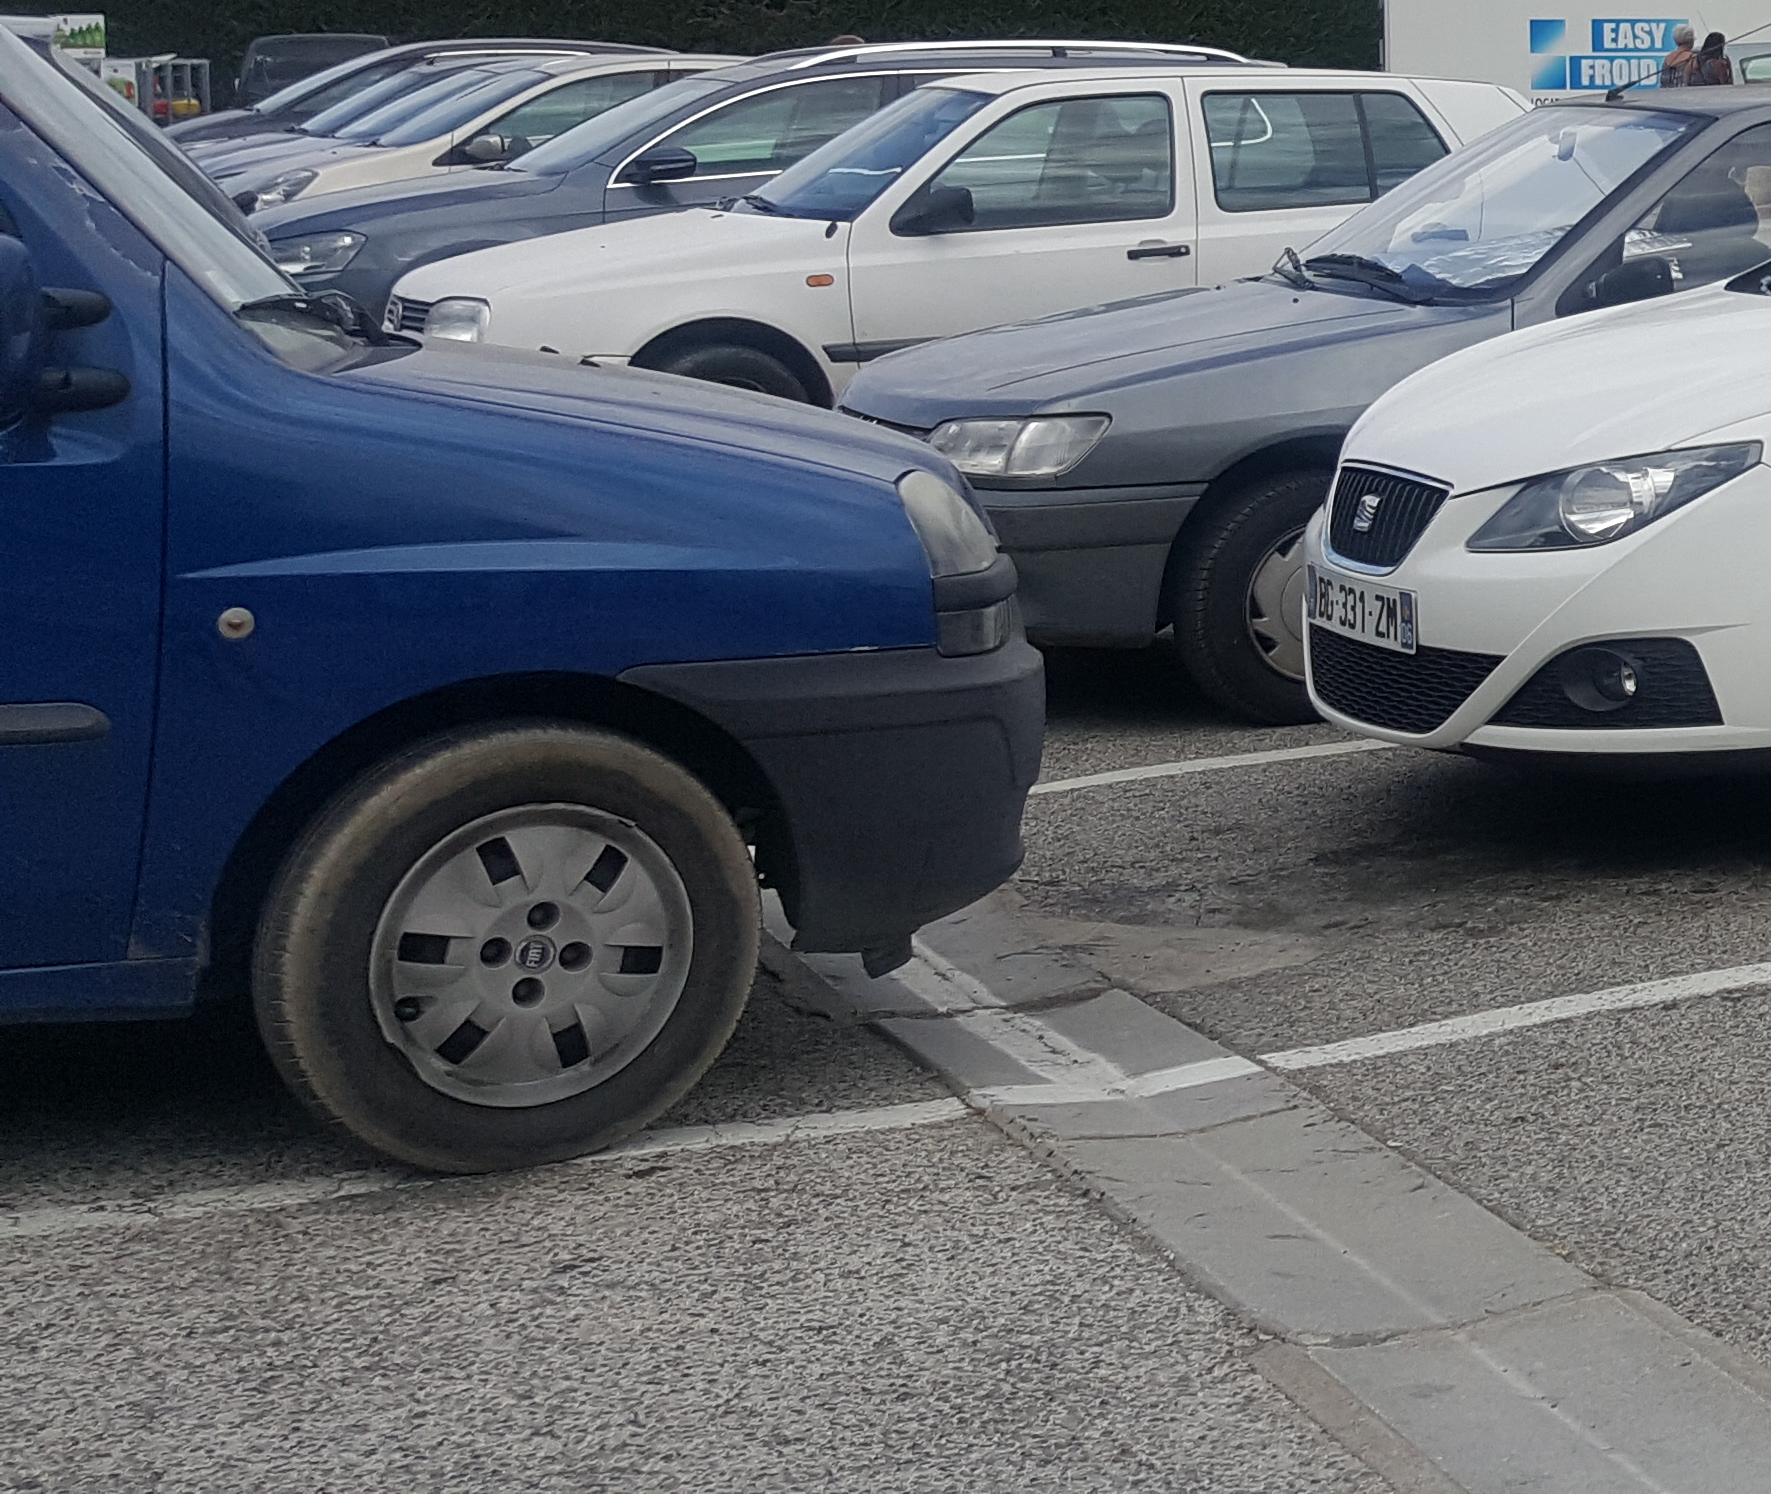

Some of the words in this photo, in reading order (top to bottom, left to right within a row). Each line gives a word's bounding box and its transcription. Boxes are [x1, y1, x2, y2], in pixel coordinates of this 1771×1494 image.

[1602, 22, 1667, 49] EASY
[1580, 58, 1658, 86] FROID
[1318, 576, 1398, 642] BG-331-ZM
